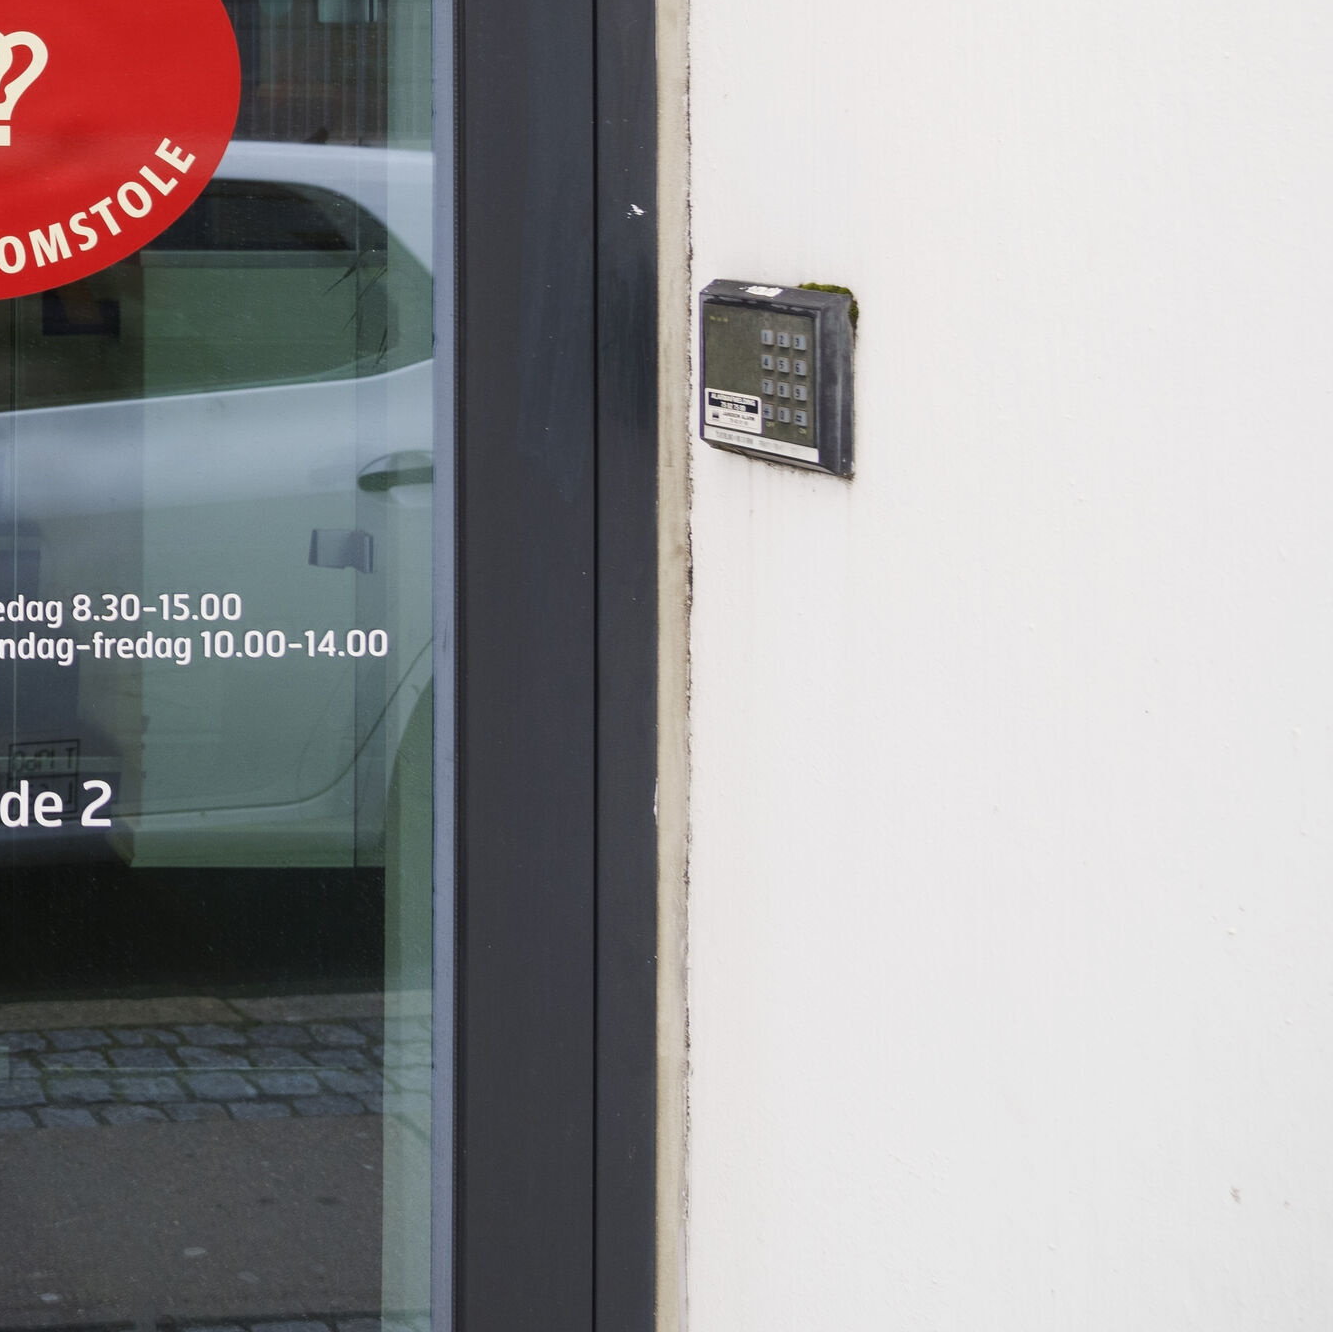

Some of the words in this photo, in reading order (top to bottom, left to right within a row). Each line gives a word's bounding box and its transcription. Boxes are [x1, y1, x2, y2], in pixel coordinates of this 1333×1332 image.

[72, 593, 242, 622] 8.30-15.00
[200, 629, 389, 658] 10.00-14.00
[81, 779, 112, 827] 2
